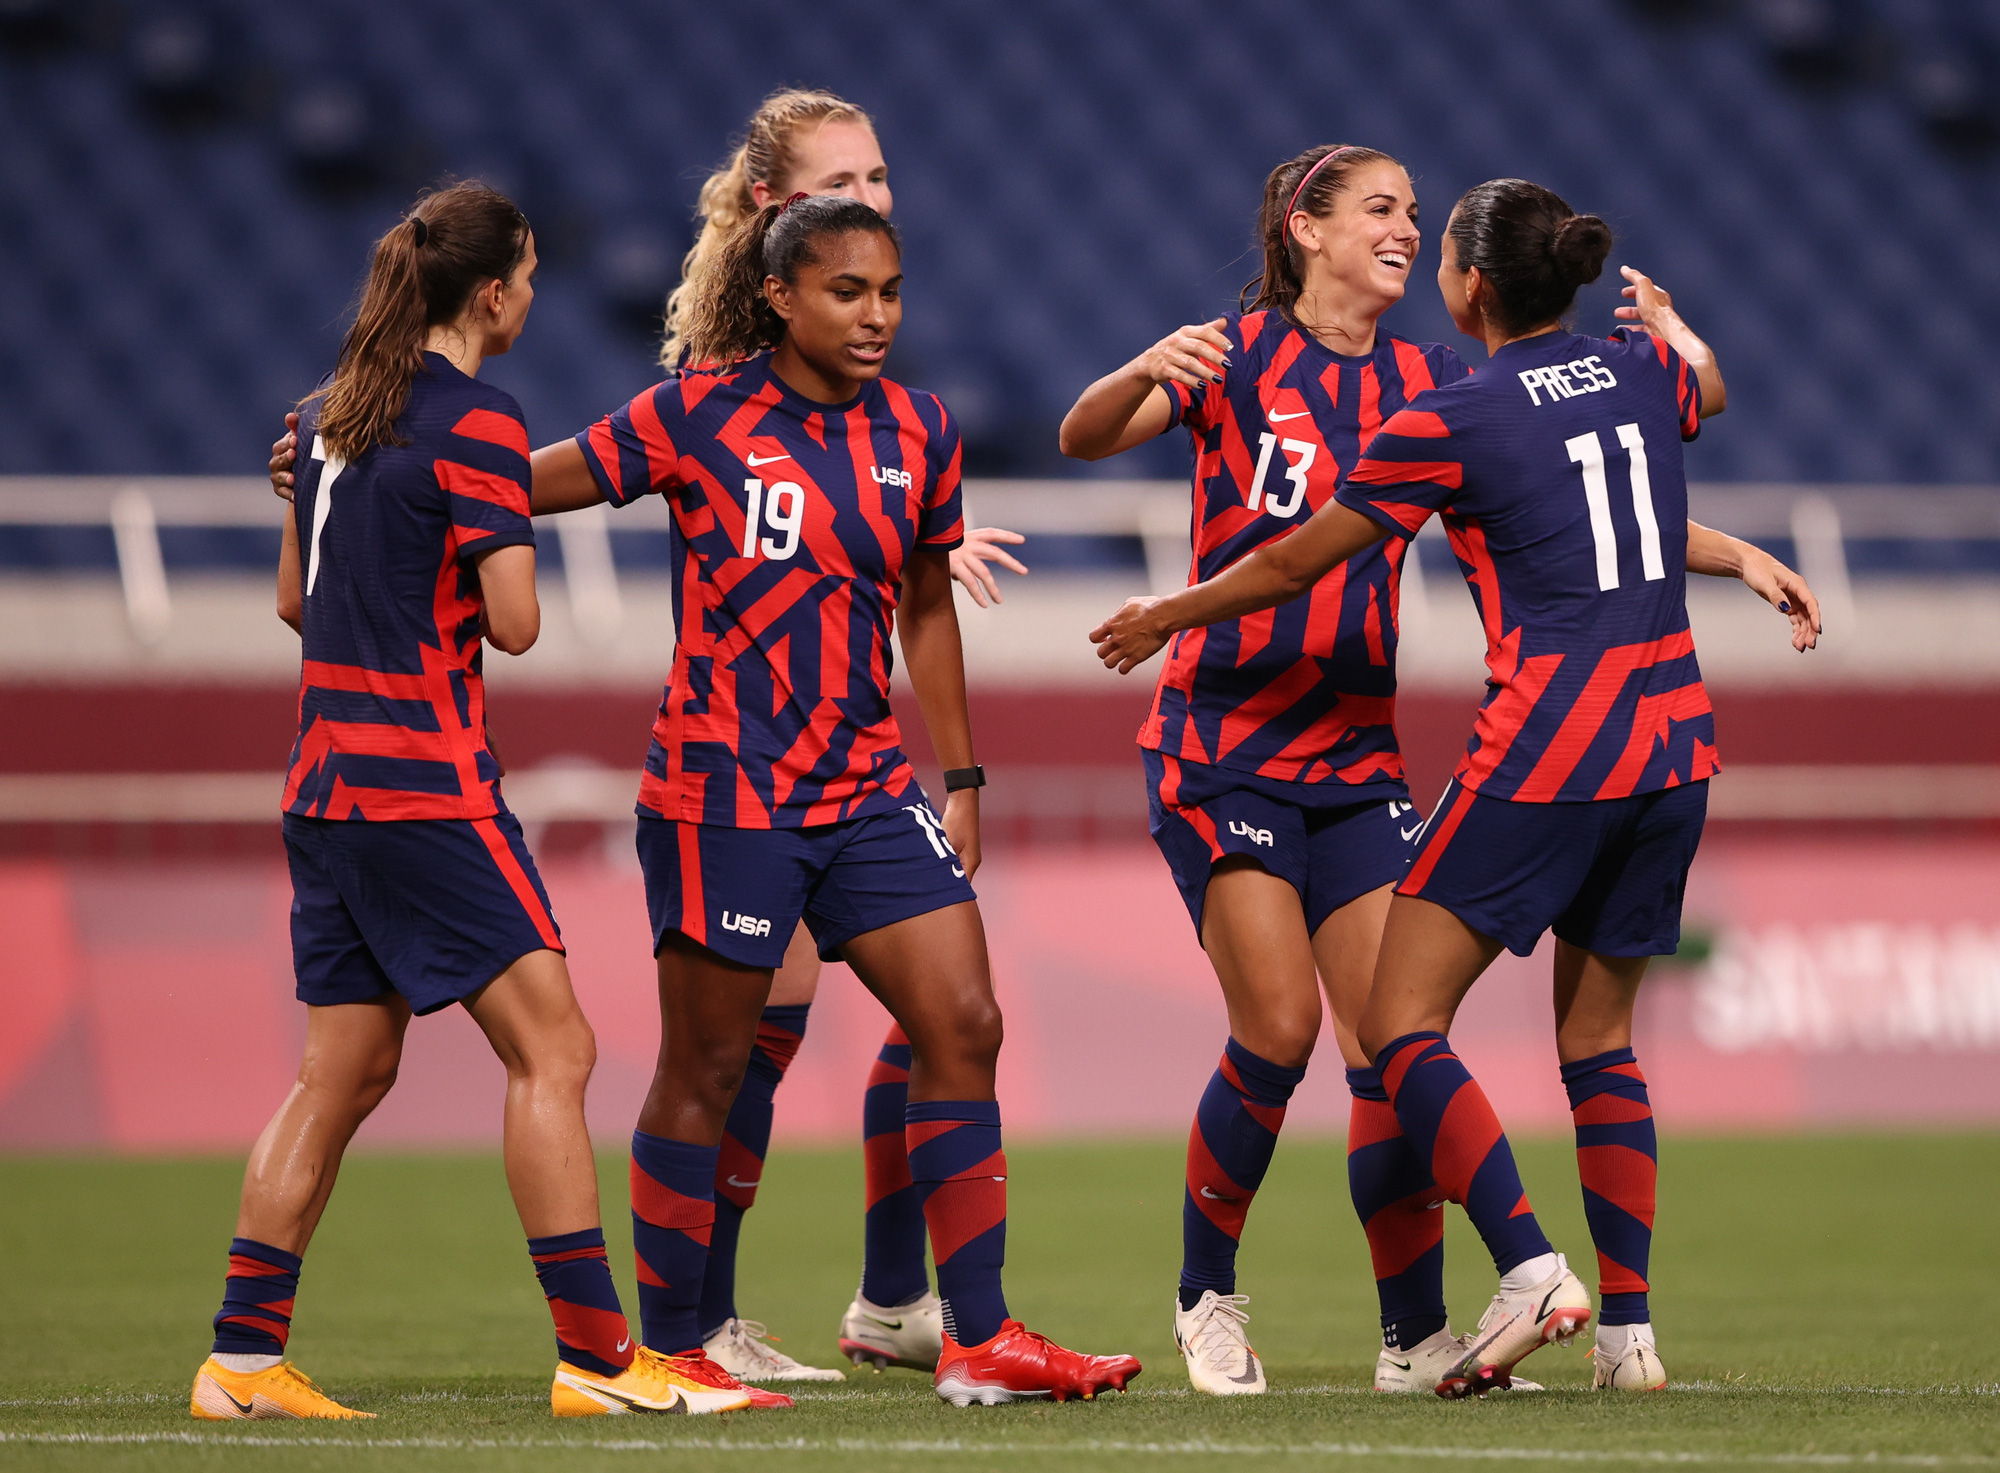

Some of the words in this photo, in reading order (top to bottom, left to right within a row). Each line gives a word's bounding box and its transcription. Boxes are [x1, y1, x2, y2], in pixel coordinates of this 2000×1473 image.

[1518, 355, 1617, 406] PRESS
[870, 465, 913, 490] USA
[1246, 431, 1318, 518] 13
[1564, 422, 1666, 591] 11
[306, 434, 347, 596] 7
[742, 478, 805, 561] 19
[1228, 820, 1274, 847] USA
[721, 910, 772, 938] USA
